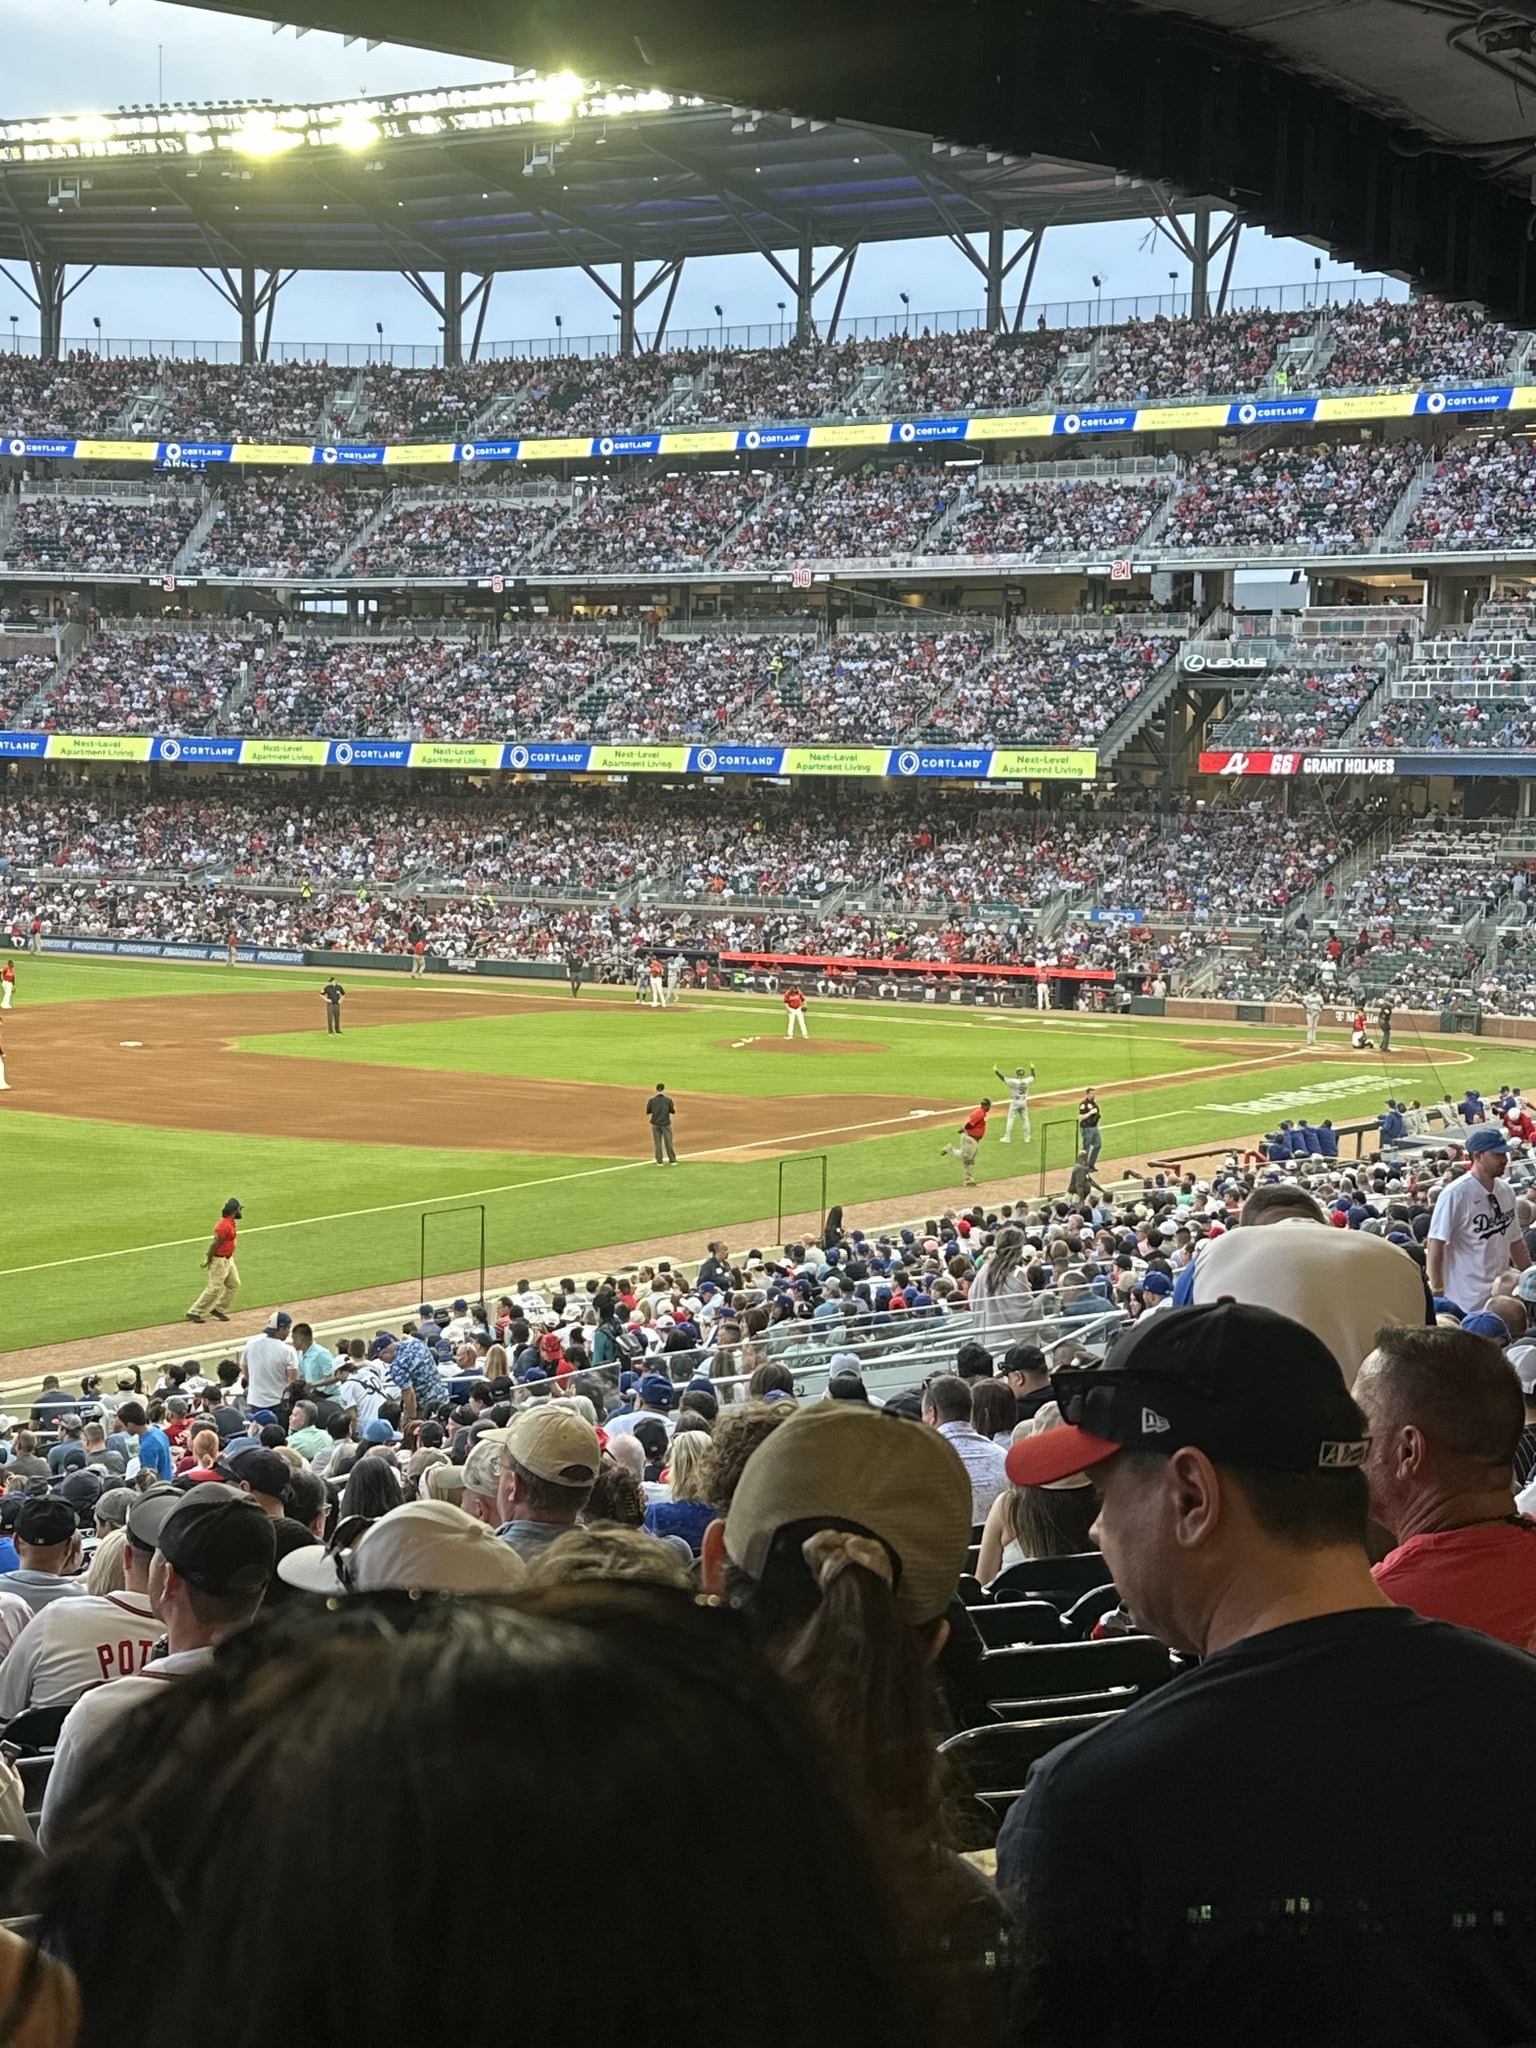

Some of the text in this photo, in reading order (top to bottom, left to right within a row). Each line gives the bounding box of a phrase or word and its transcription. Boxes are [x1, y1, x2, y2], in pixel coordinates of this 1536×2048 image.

[1446, 396, 1500, 407] CORTLAND
[1257, 406, 1306, 417] CORTLAND
[1081, 418, 1126, 428] CORTLAND
[916, 426, 959, 436] CORTLAND
[760, 434, 801, 443] CORTLAND
[1111, 560, 1132, 581] 21
[163, 574, 175, 592] 3
[792, 568, 812, 588] 10
[492, 574, 504, 593] 6
[1206, 656, 1267, 669] LEXUS
[0, 742, 39, 751] RTLAND
[73, 739, 121, 748] Next-Level
[60, 747, 134, 758] Apartment Living
[183, 746, 235, 756] CORTLAND
[354, 750, 403, 759] CORTLAND
[615, 750, 659, 758] Next-Level
[530, 752, 583, 762] CORTLAND
[719, 756, 775, 765] CORTLAND
[809, 752, 857, 762] Next-Level
[1017, 755, 1069, 765] Next-Level
[602, 759, 672, 769] Apartment Living
[796, 762, 871, 773] Apartment Living
[922, 758, 982, 768] CORTLAND
[1270, 754, 1294, 774] 66
[1303, 758, 1395, 774] GRANT HOLMES
[1002, 765, 1084, 776] Apartment Living
[1346, 1011, 1379, 1024] Mile
